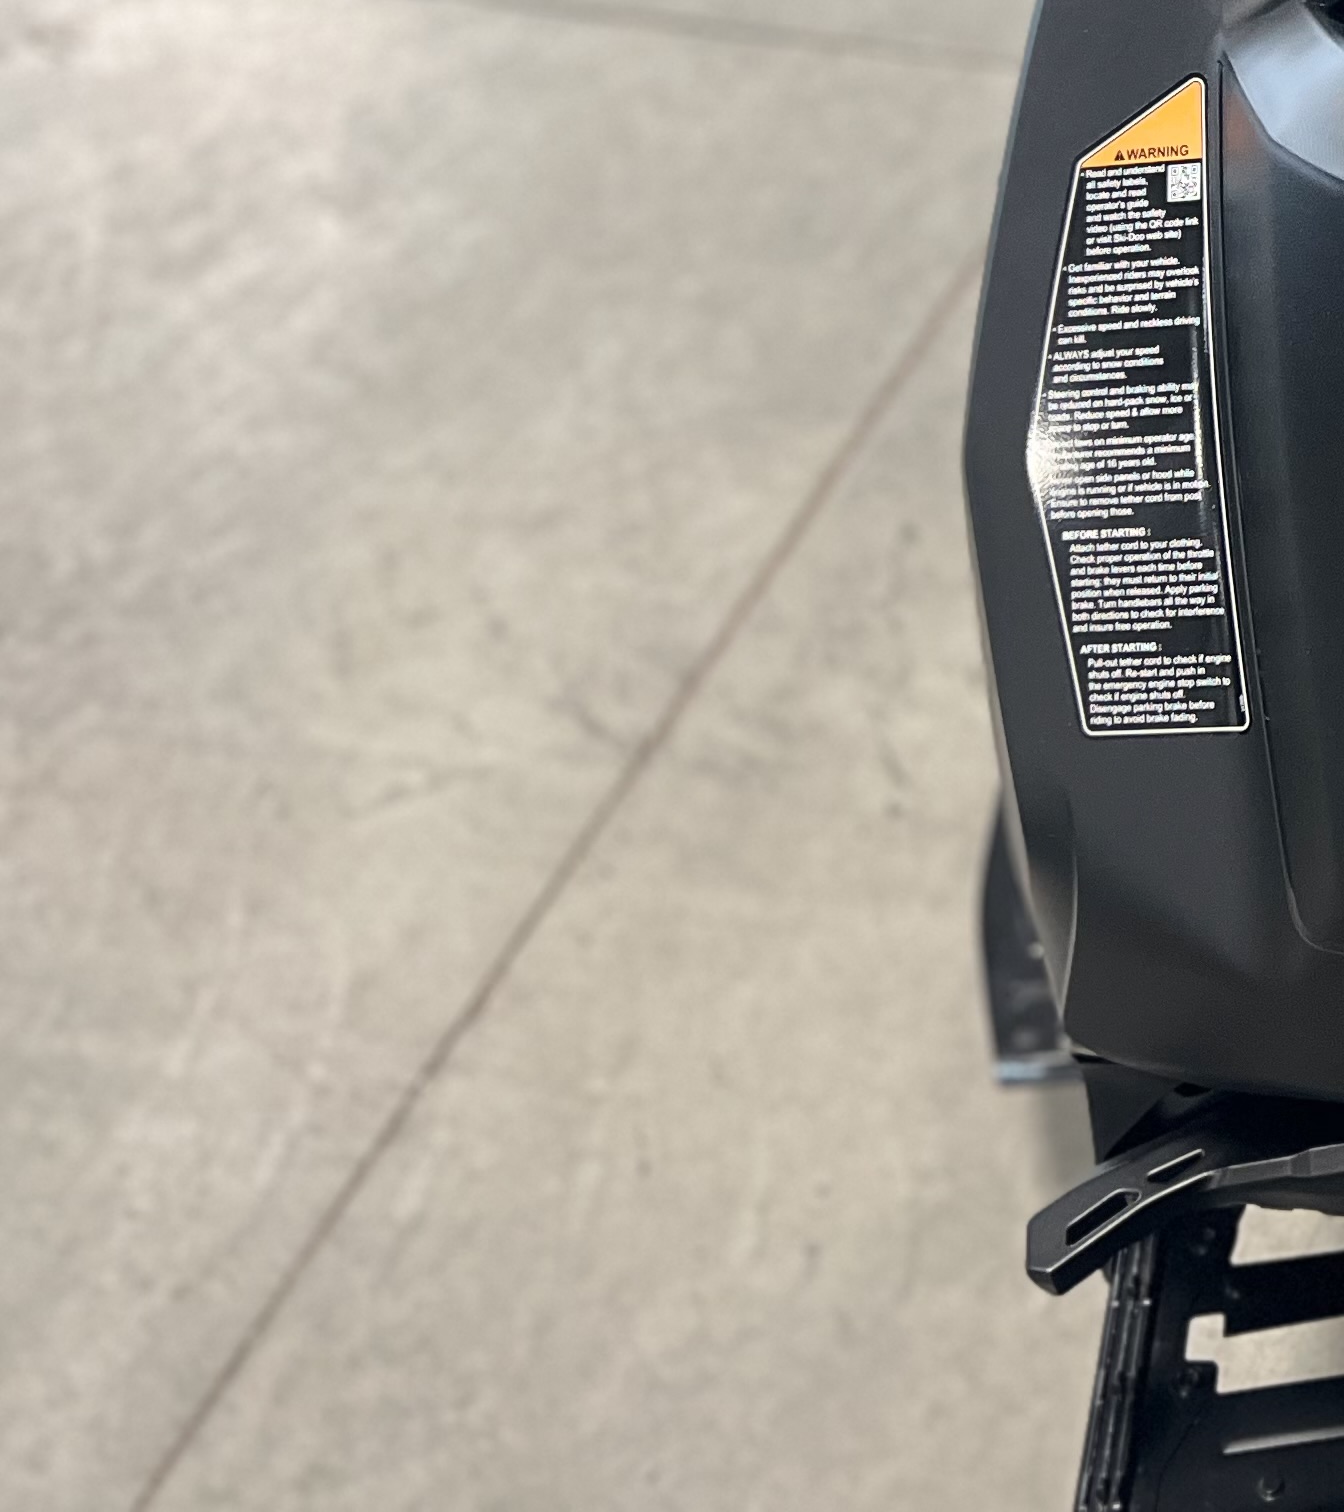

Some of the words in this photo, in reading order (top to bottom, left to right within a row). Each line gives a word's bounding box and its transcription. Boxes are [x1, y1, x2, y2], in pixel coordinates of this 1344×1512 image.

[1127, 145, 1189, 160] WARNING
[1062, 529, 1098, 540] BEFORE
[1100, 527, 1145, 538] STARTING
[1080, 643, 1109, 653] AFTER
[1111, 642, 1156, 653] STARTING
